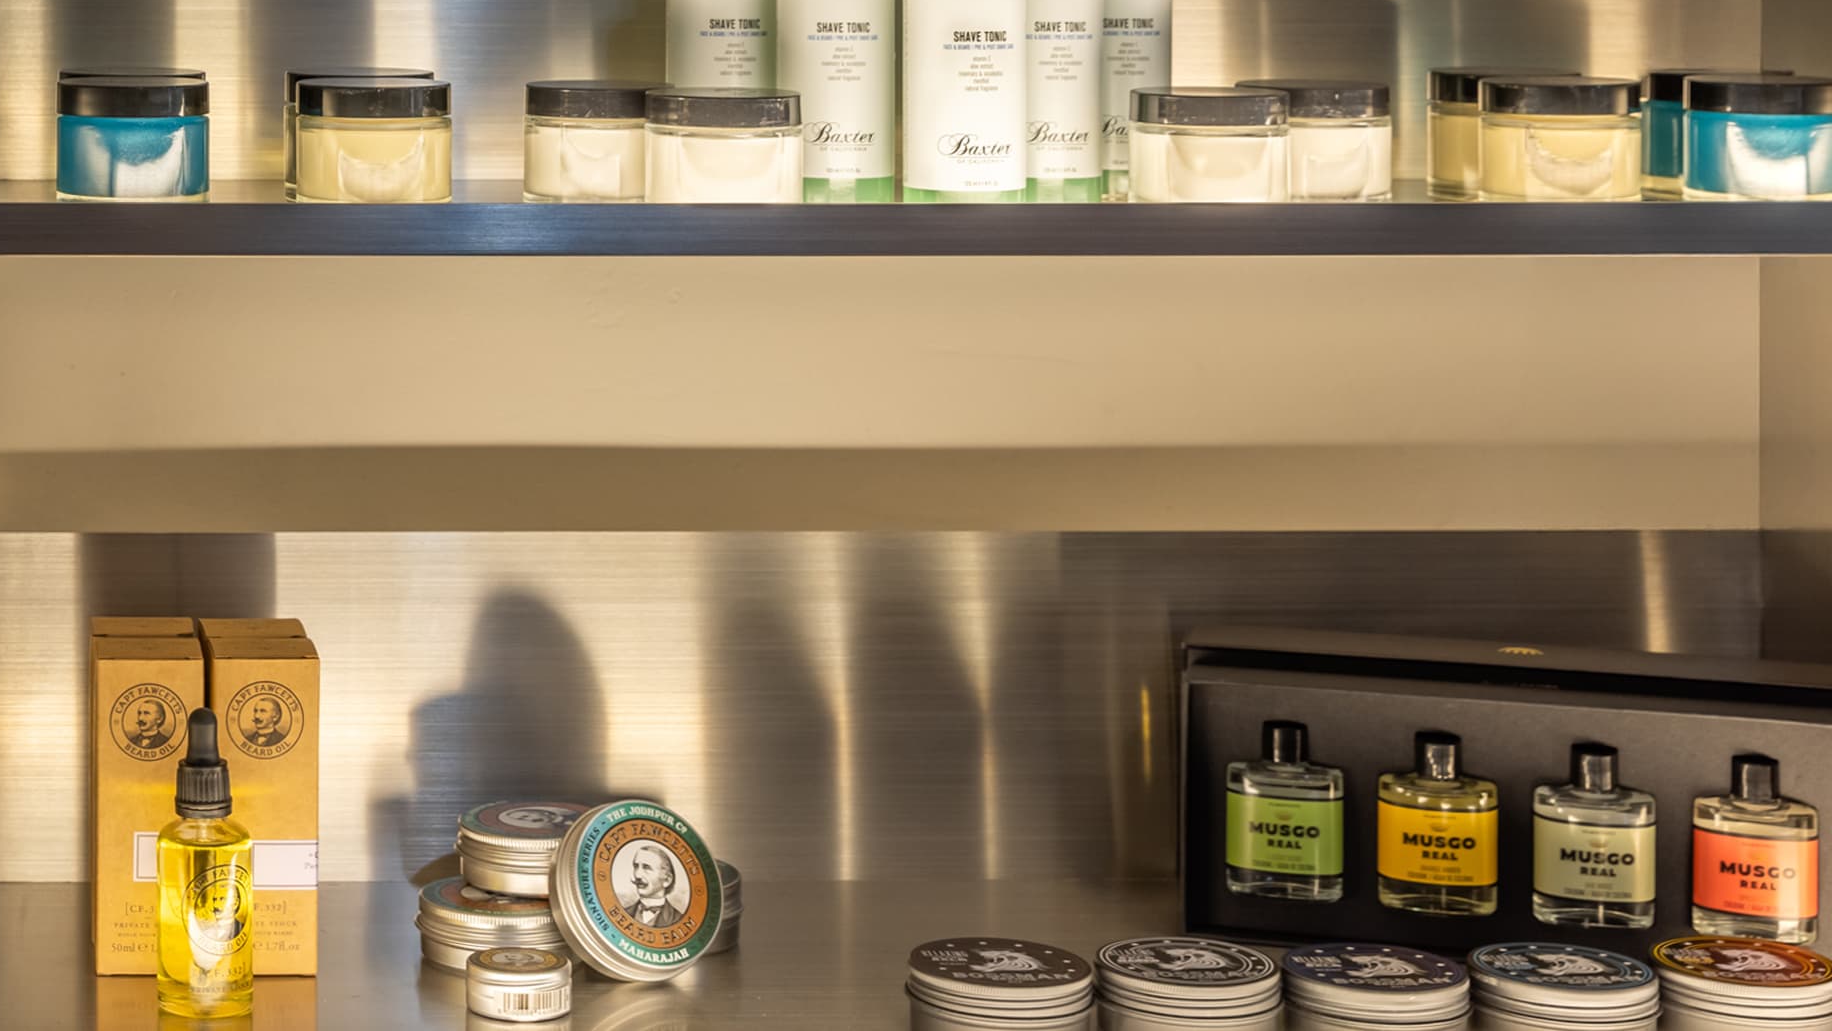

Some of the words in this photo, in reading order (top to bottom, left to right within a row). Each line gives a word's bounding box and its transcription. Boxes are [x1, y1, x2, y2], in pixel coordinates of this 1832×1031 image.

[709, 19, 736, 30] SHAVE
[739, 19, 760, 29] TONIC
[816, 22, 844, 33] SHAVE
[847, 22, 871, 33] TONIC
[1034, 21, 1062, 33] SHAVE
[1065, 21, 1087, 33] TONIC
[1102, 18, 1130, 29] SHAVE
[1132, 18, 1154, 29] TONIC
[953, 31, 981, 42] SHAVE
[984, 31, 1007, 42] TONIC
[804, 121, 876, 144] Baxter
[1026, 120, 1089, 144] Baxter
[938, 132, 1013, 156] Baxter
[115, 687, 136, 715] CAPT
[231, 686, 252, 712] CAPT
[124, 741, 157, 759] BEARD
[159, 741, 176, 758] OIL
[240, 740, 273, 757] BEARD
[275, 739, 291, 754] OIL
[606, 808, 627, 822] THE
[629, 806, 675, 825] JODHPUR
[1249, 821, 1320, 839] MUSGO
[582, 827, 600, 864] SERIES
[599, 827, 627, 860] CAPT
[1267, 838, 1303, 850] REAL
[1402, 832, 1476, 850] MUSGO
[1422, 850, 1458, 861] REAL
[1559, 848, 1635, 866] MUSGO
[1580, 866, 1616, 878] REAL
[1719, 861, 1796, 879] MUSGO
[1740, 879, 1776, 891] REAL
[582, 868, 610, 932] SIGNATURE
[609, 906, 656, 944] BEARD
[618, 938, 690, 963] MAHARAJAH
